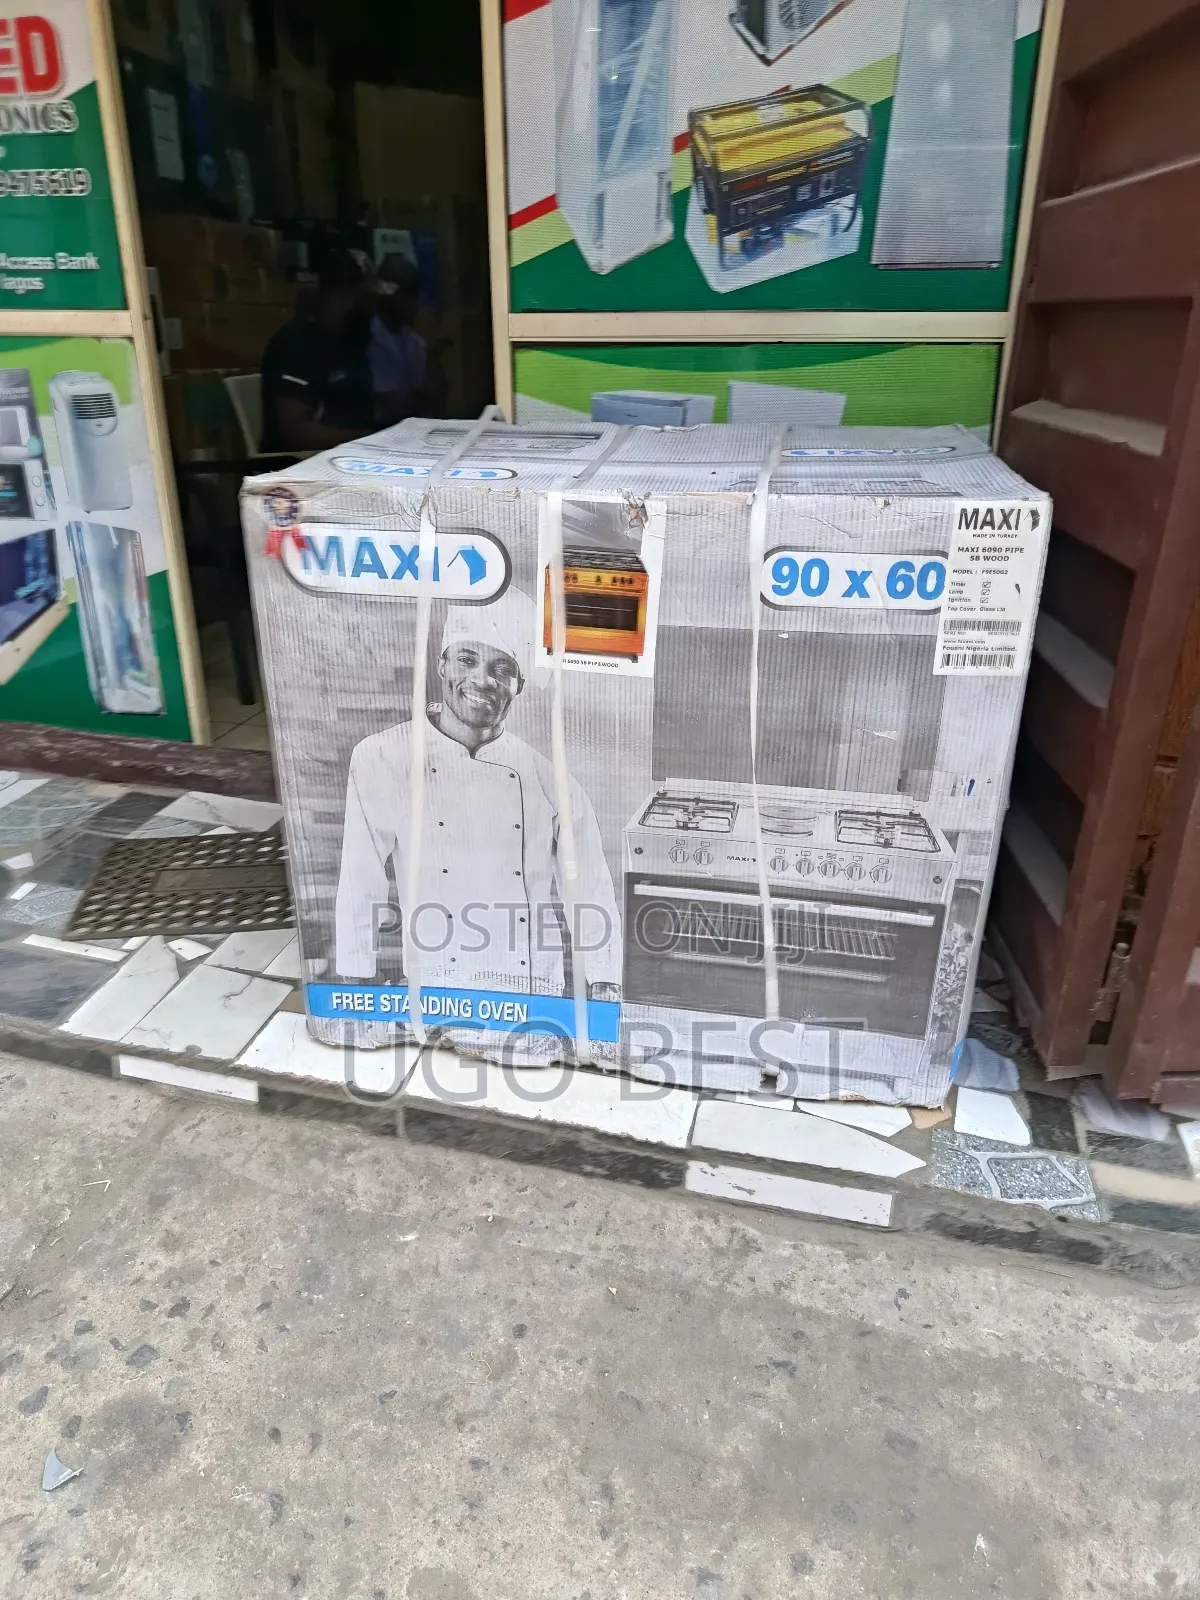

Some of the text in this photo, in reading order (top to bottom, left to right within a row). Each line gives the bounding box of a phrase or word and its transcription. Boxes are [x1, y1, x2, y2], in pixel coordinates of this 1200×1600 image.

[55, 252, 100, 270] Bank
[957, 507, 1022, 531] MAXI
[771, 556, 947, 600] 90 x 60
[966, 645, 990, 653] Nigeria
[331, 992, 528, 1023] FREE STANDING OVEN
